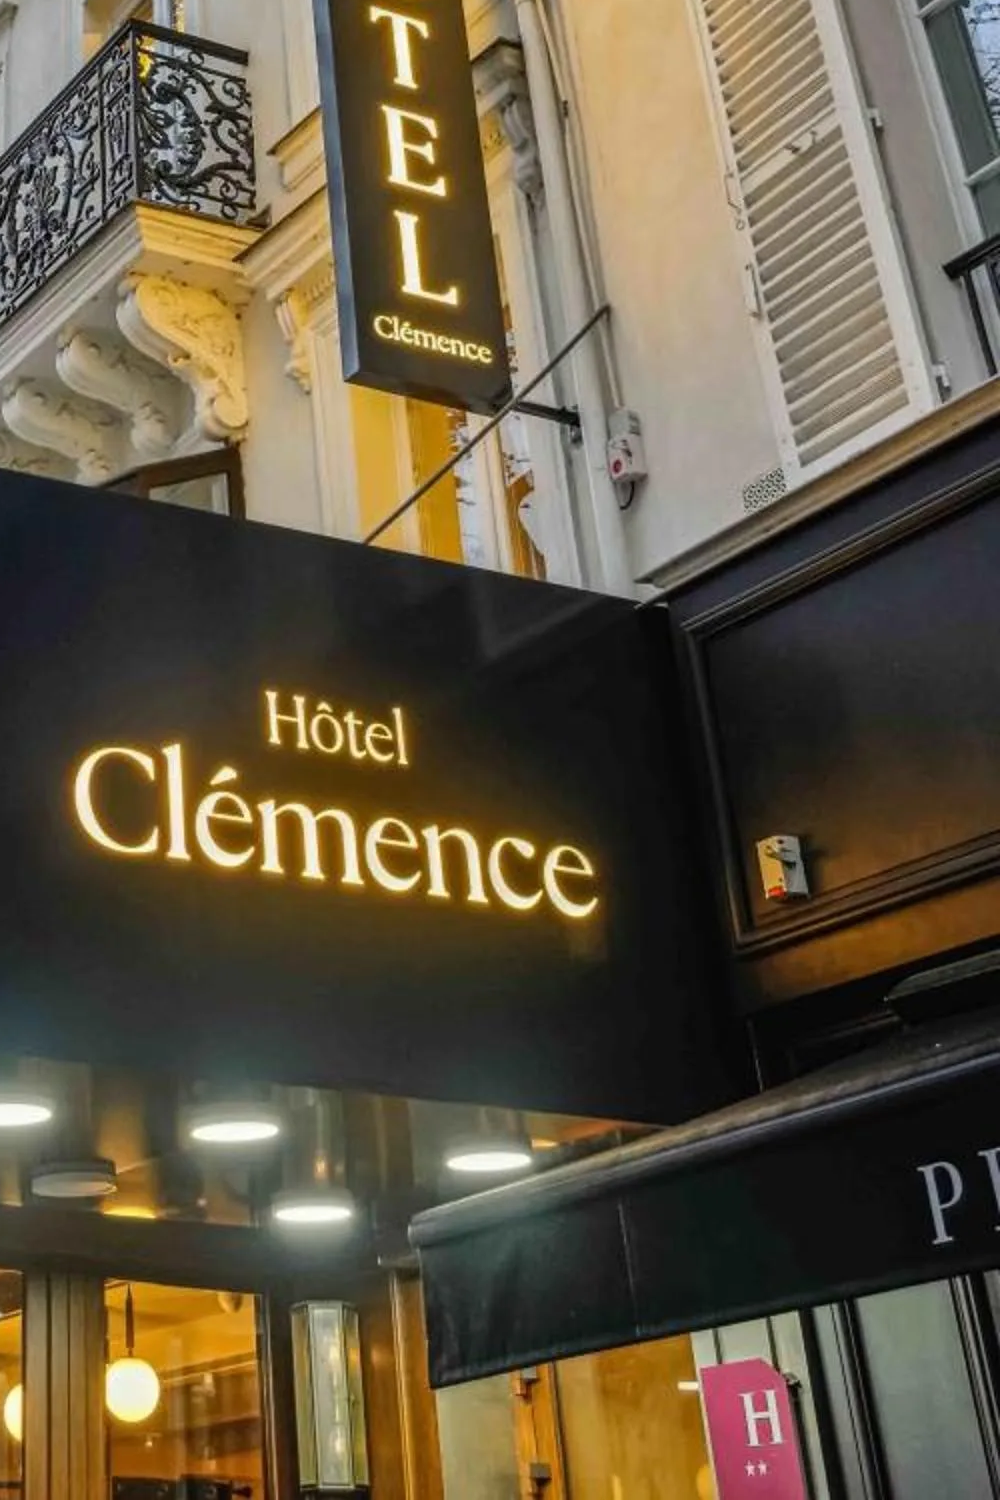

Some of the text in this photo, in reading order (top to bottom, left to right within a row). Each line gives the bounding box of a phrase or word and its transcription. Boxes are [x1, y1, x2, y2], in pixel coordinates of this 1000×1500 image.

[373, 314, 492, 364] Clémence
[265, 690, 408, 765] Hôtel
[74, 743, 599, 918] Clémence
[738, 1388, 784, 1447] H
